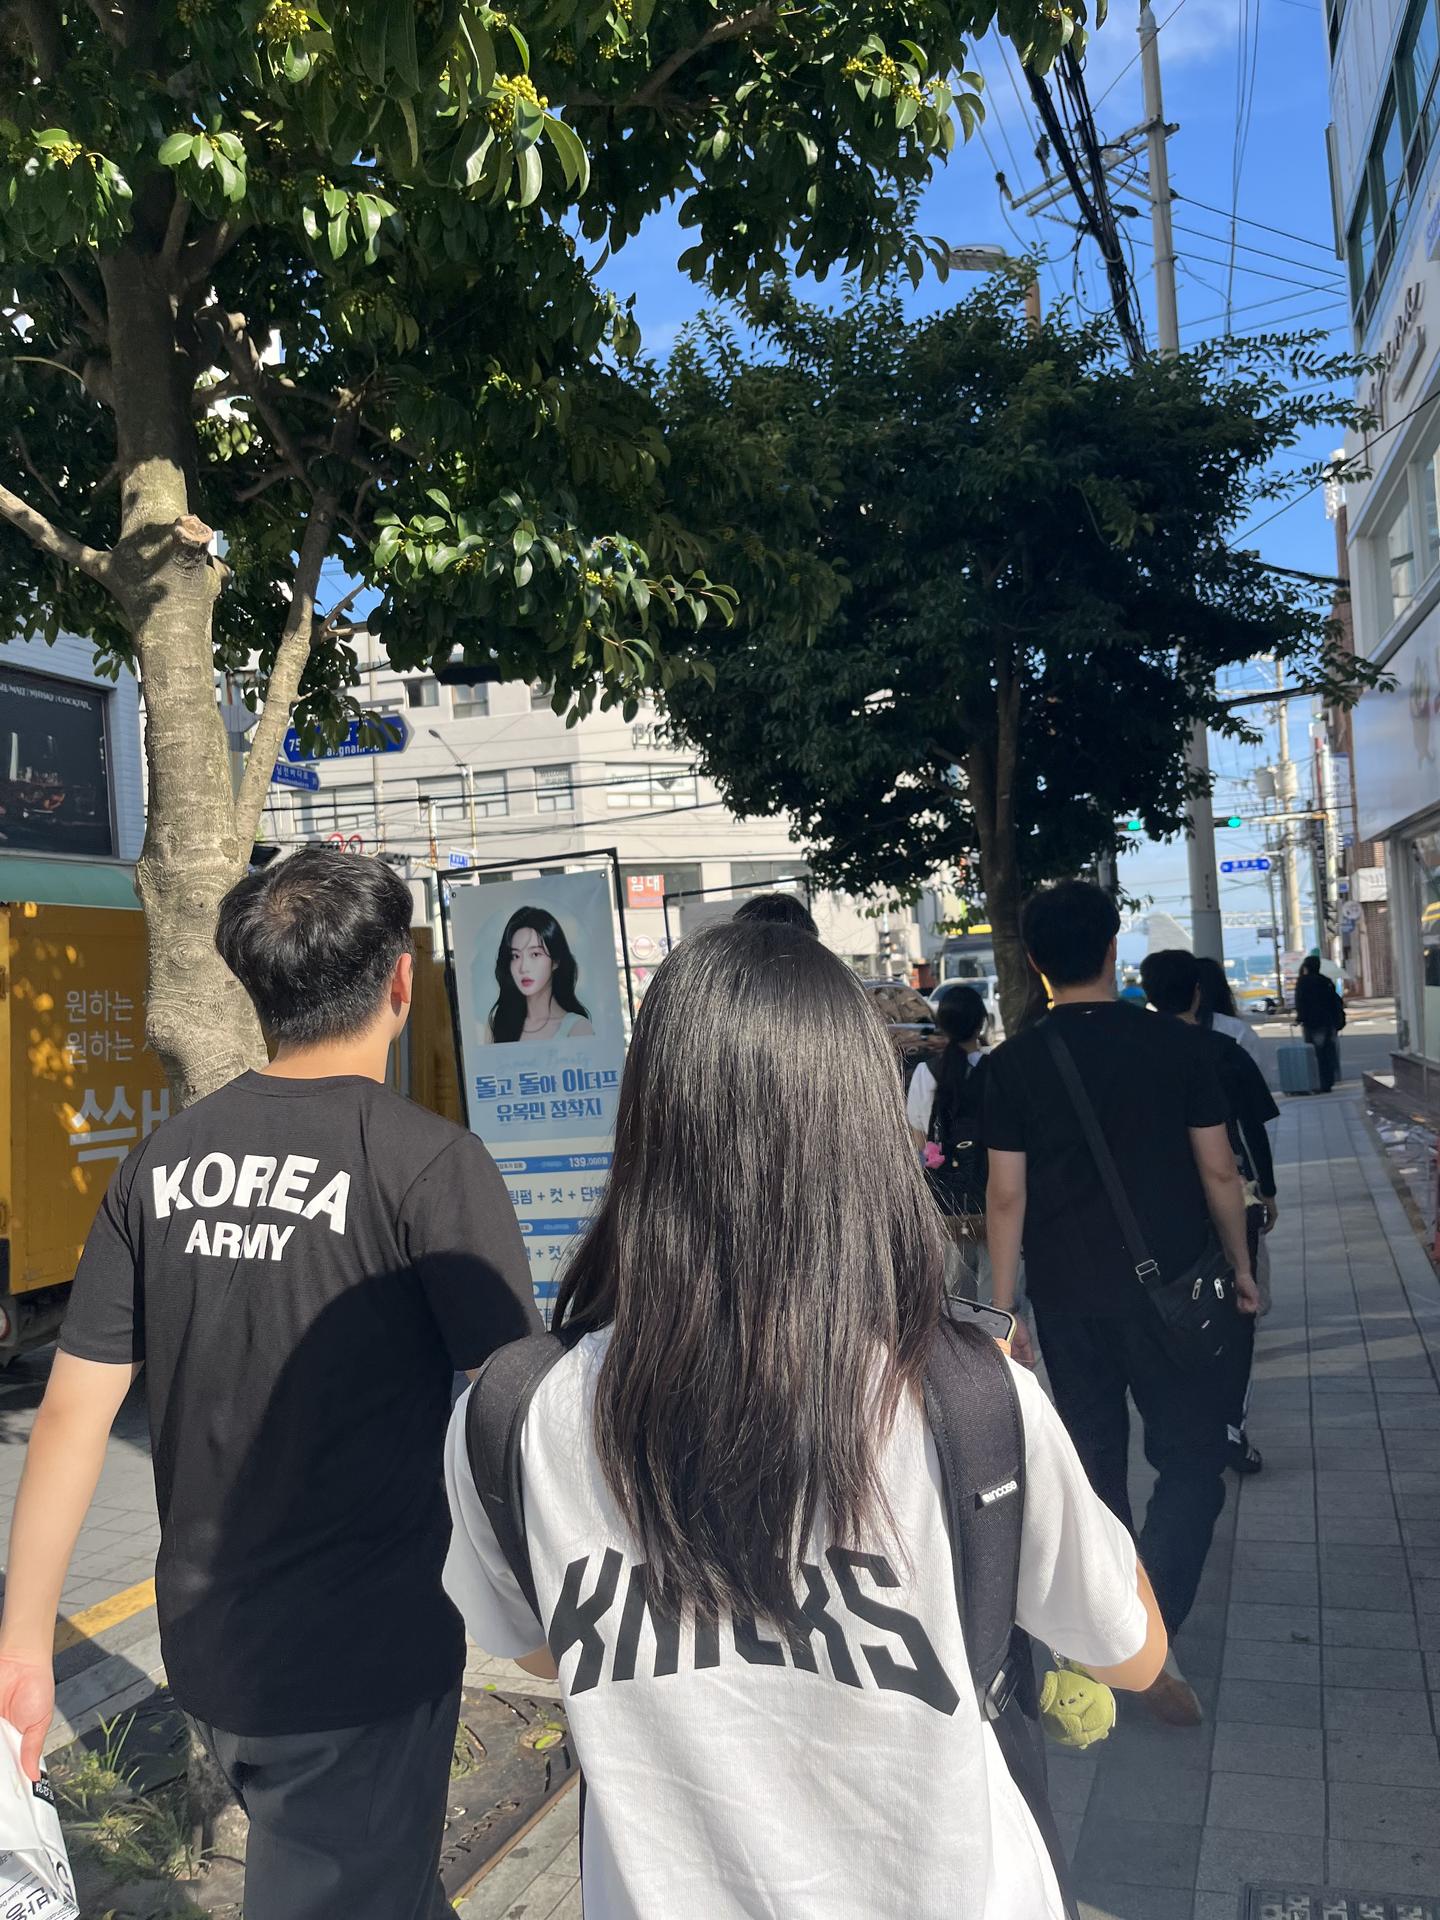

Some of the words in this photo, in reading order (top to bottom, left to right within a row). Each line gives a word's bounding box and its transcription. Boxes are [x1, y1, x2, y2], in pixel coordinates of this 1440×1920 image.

[631, 876, 660, 892] 임대
[65, 990, 134, 1023] 원하는
[65, 1030, 134, 1065] 원하는
[475, 1076, 513, 1099] 돌고
[518, 1072, 557, 1096] 돌아
[562, 1069, 619, 1092] 이더프
[496, 1102, 547, 1122] 유목민
[550, 1098, 602, 1119] 정착지
[152, 1151, 351, 1235] KOREA
[550, 1188, 563, 1203] 컷
[184, 1219, 296, 1261] ARMY
